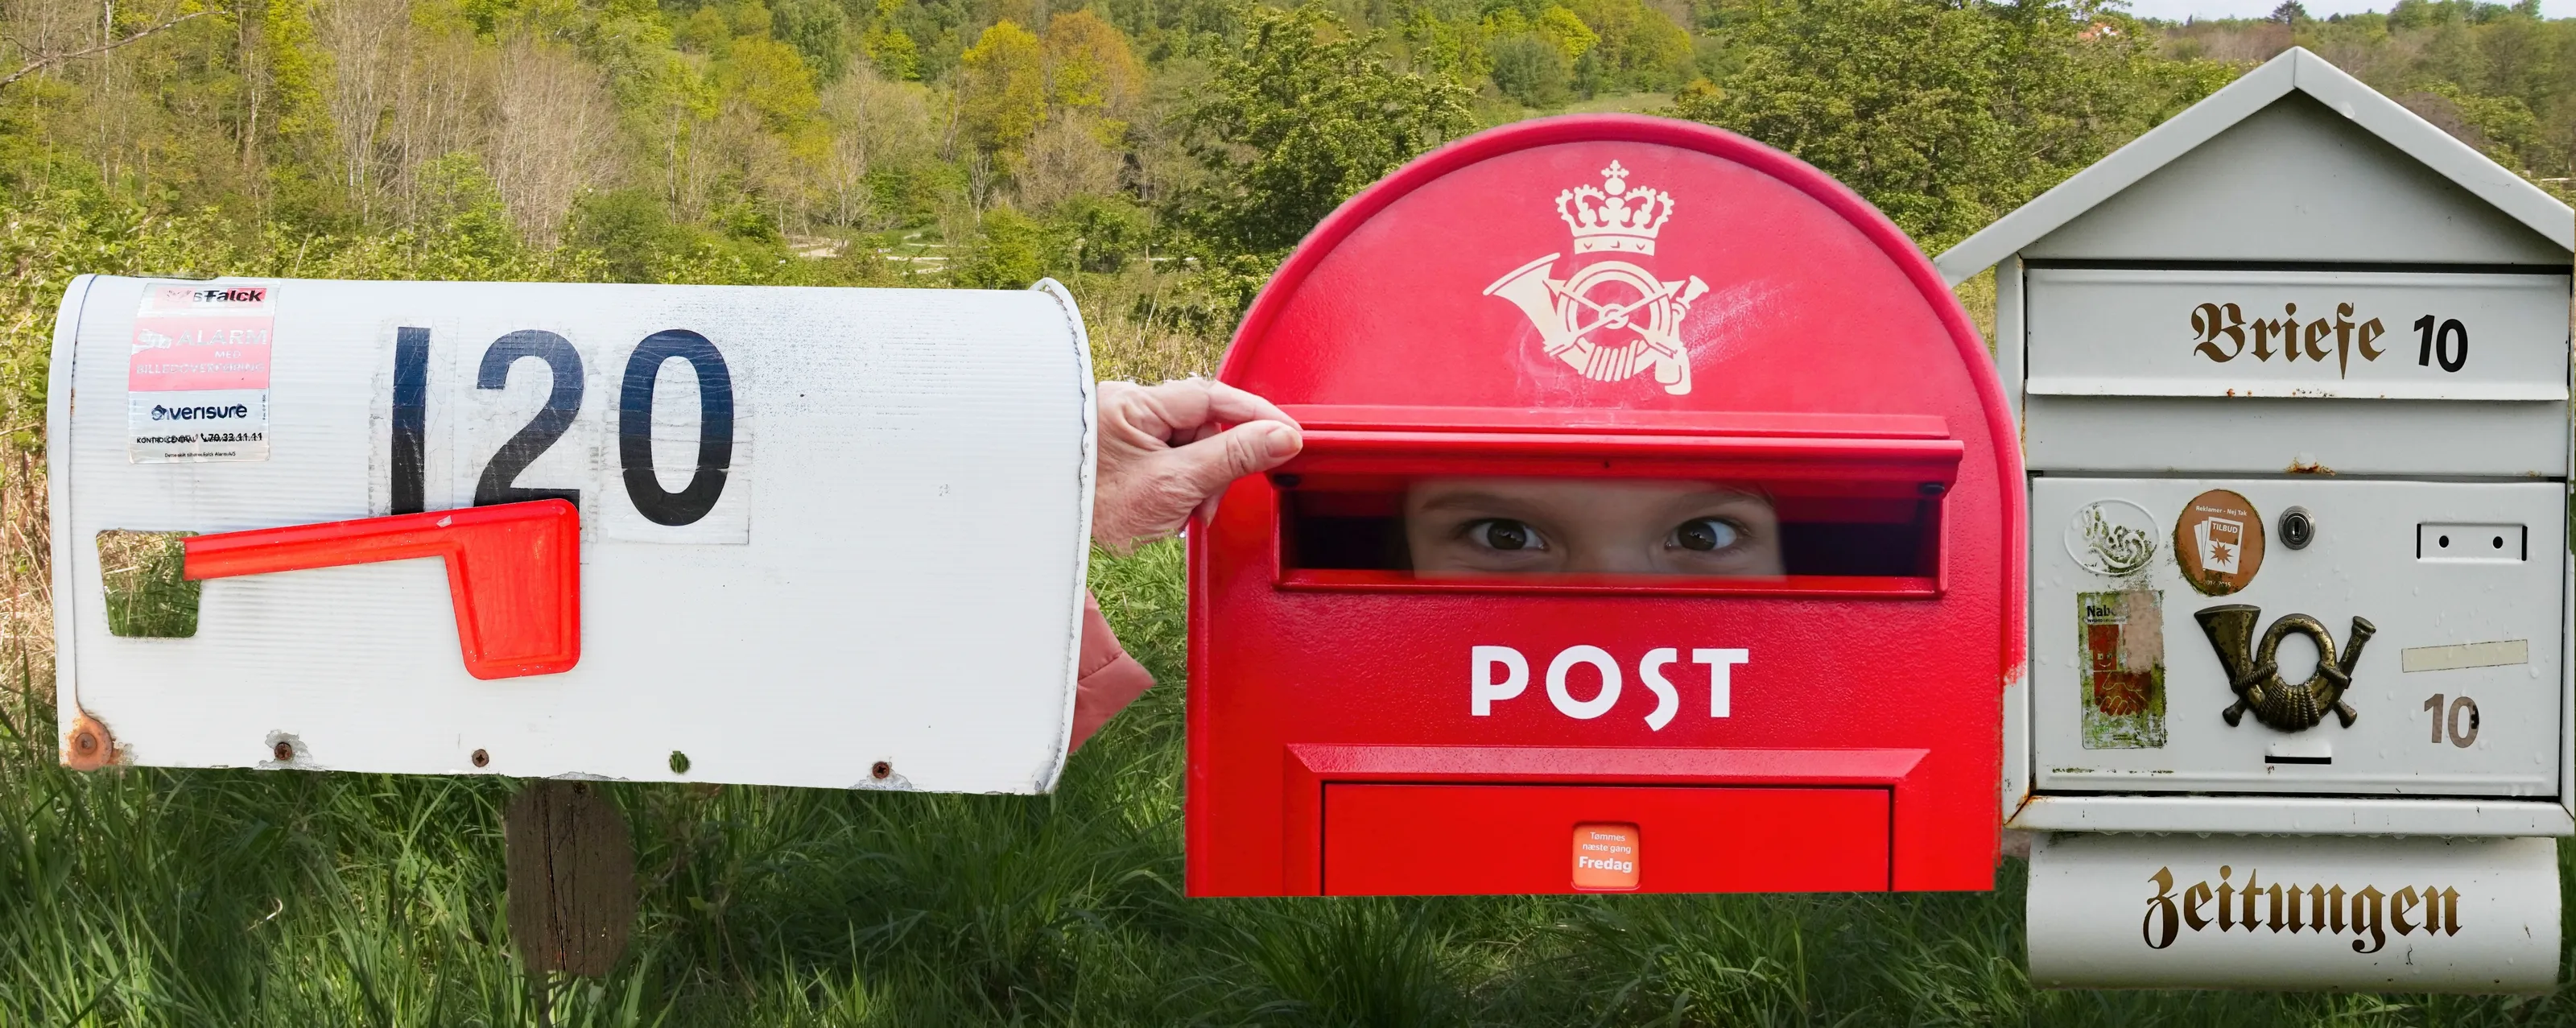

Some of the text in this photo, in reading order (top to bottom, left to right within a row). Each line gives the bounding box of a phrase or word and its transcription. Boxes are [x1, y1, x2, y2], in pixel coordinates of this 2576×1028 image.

[202, 290, 262, 303] Falck
[176, 329, 268, 345] ALARM
[2190, 302, 2386, 380] Briefe
[2413, 314, 2469, 374] 10
[214, 350, 242, 359] MED
[169, 404, 248, 420] verisure
[390, 326, 734, 526] 120
[2195, 506, 2223, 514] Reklamer
[2212, 522, 2238, 534] TILBUD
[1472, 644, 1749, 732] POST
[2424, 693, 2480, 749] 10
[1590, 832, 1626, 842] Tømmes
[1582, 843, 1632, 854] næste gang
[1579, 856, 1633, 873] Fredag
[2143, 865, 2463, 954] Zeitungen
